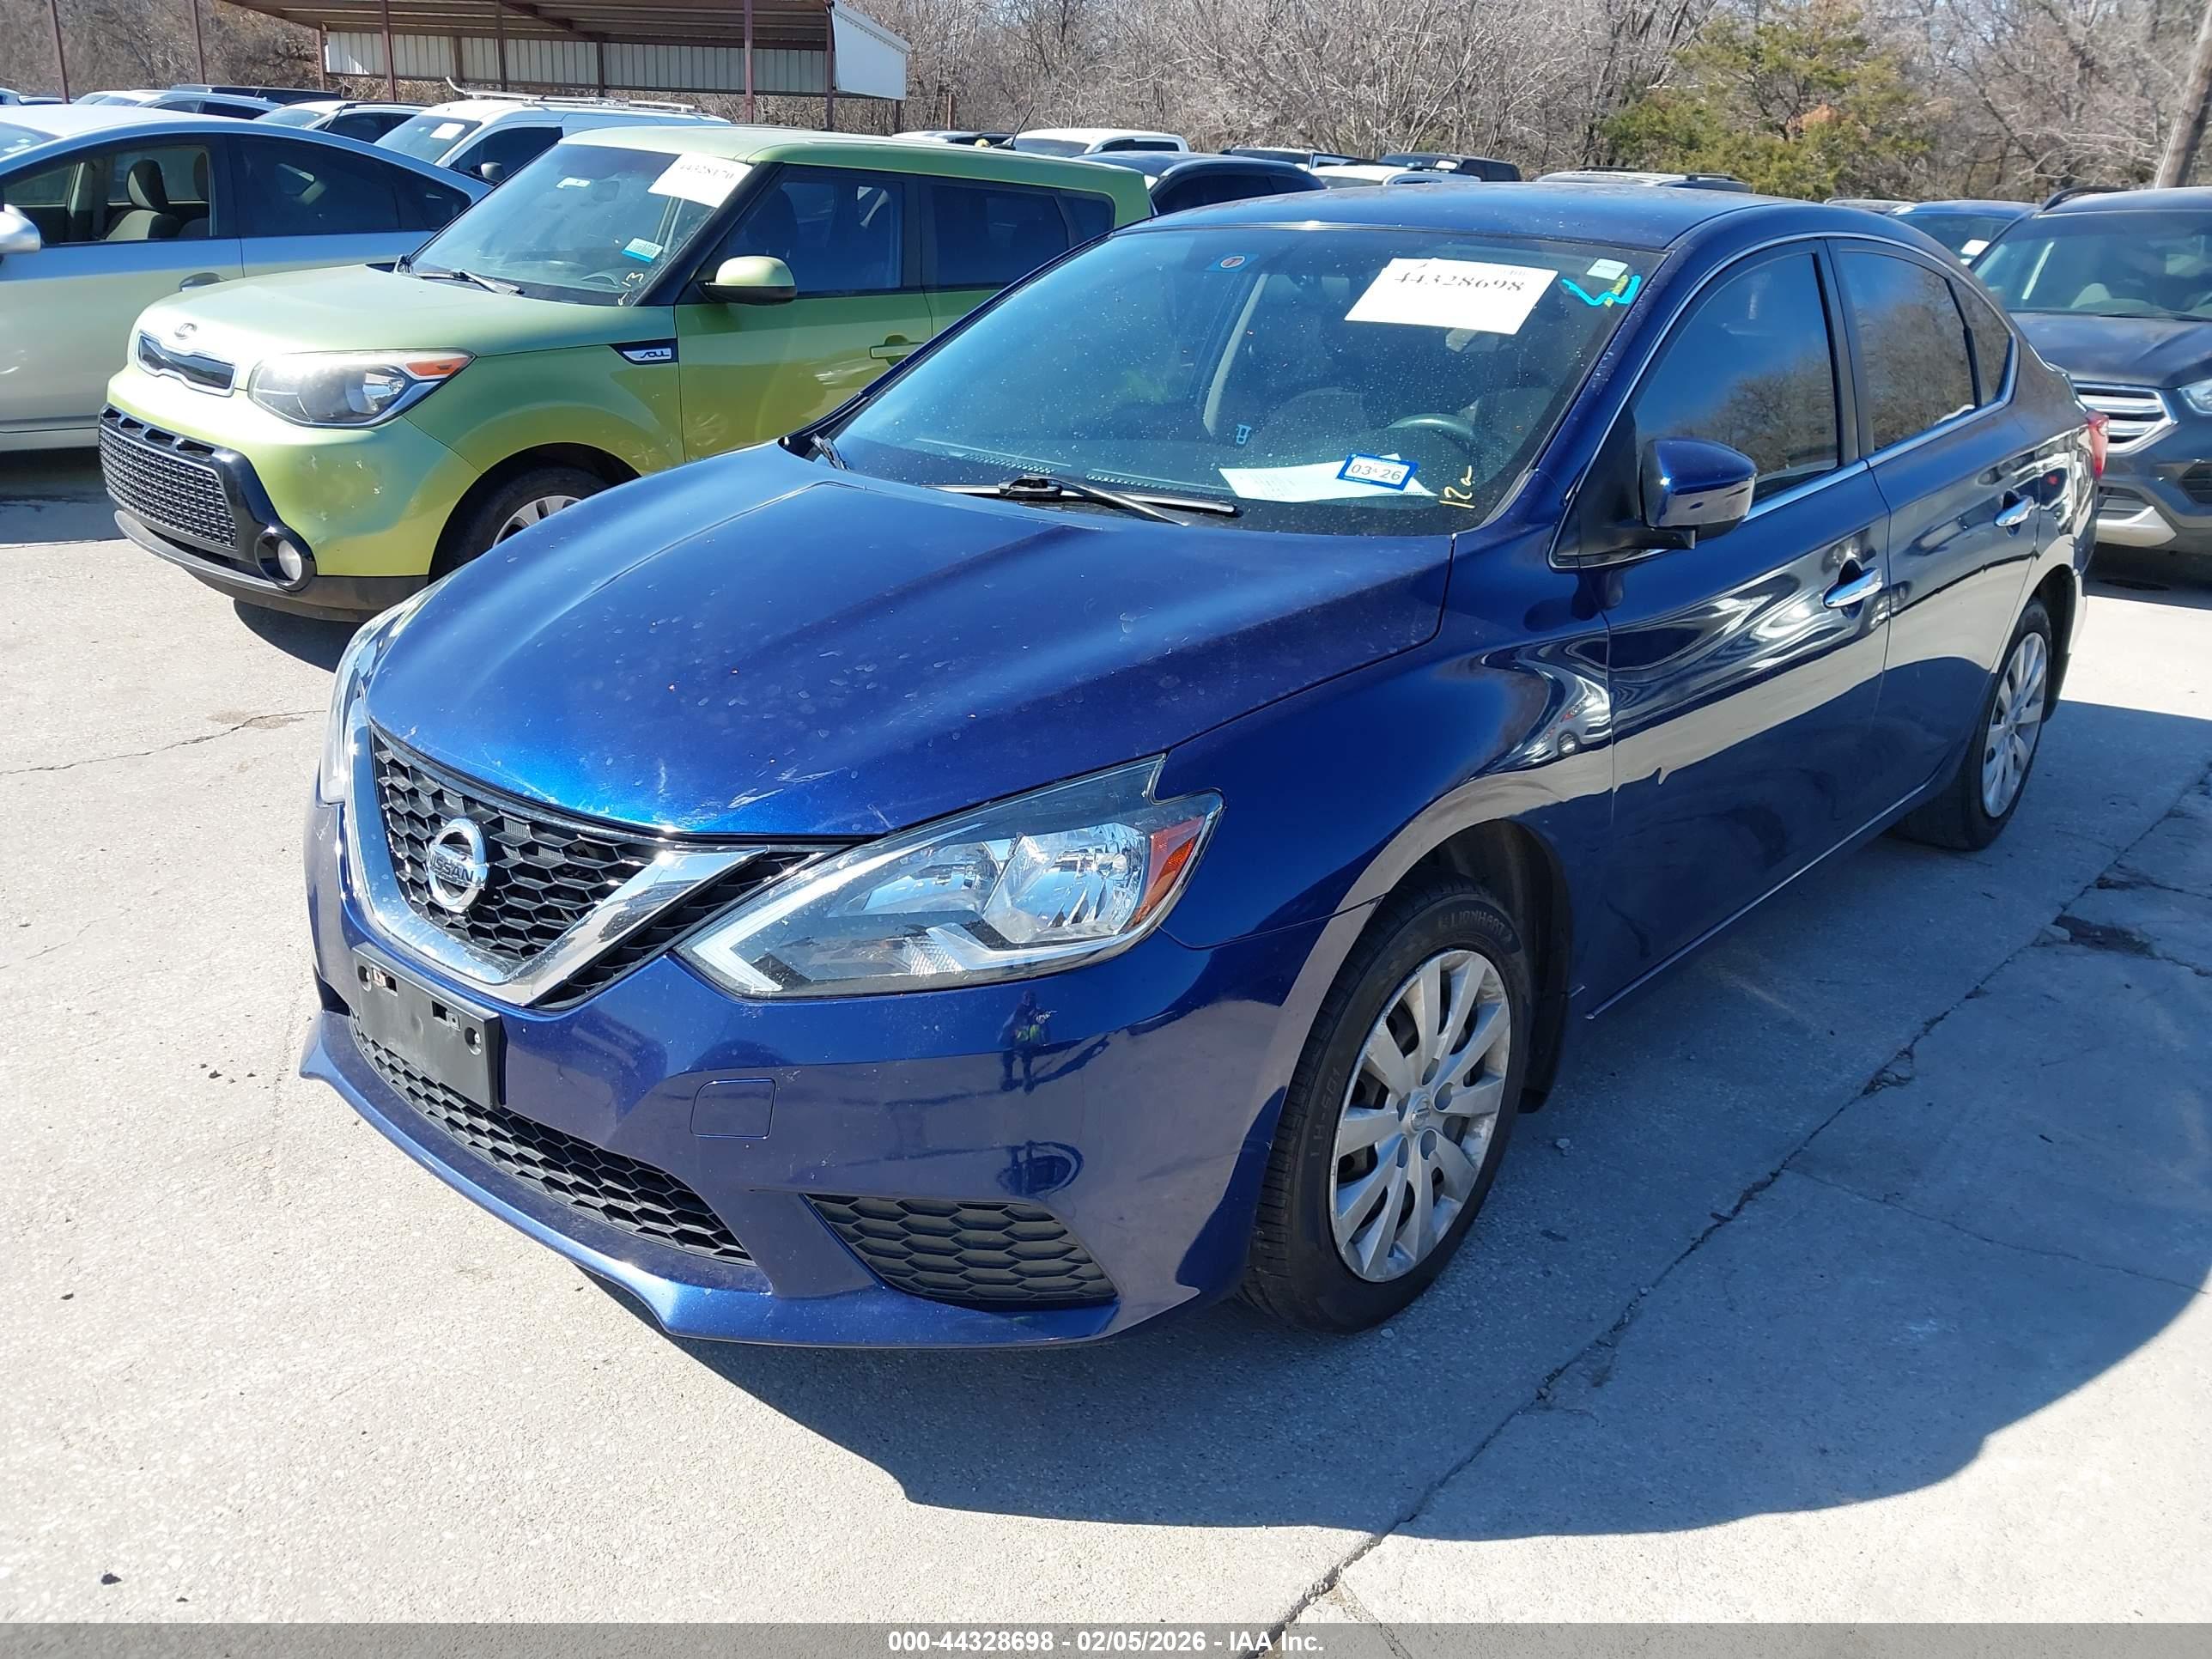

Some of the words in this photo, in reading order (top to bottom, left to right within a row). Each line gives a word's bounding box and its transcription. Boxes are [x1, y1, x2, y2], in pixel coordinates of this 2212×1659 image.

[1394, 271, 1525, 292] 44328698
[640, 350, 671, 359] SOUL
[428, 850, 474, 884] NISSAN
[1450, 910, 1505, 936] LIONHART
